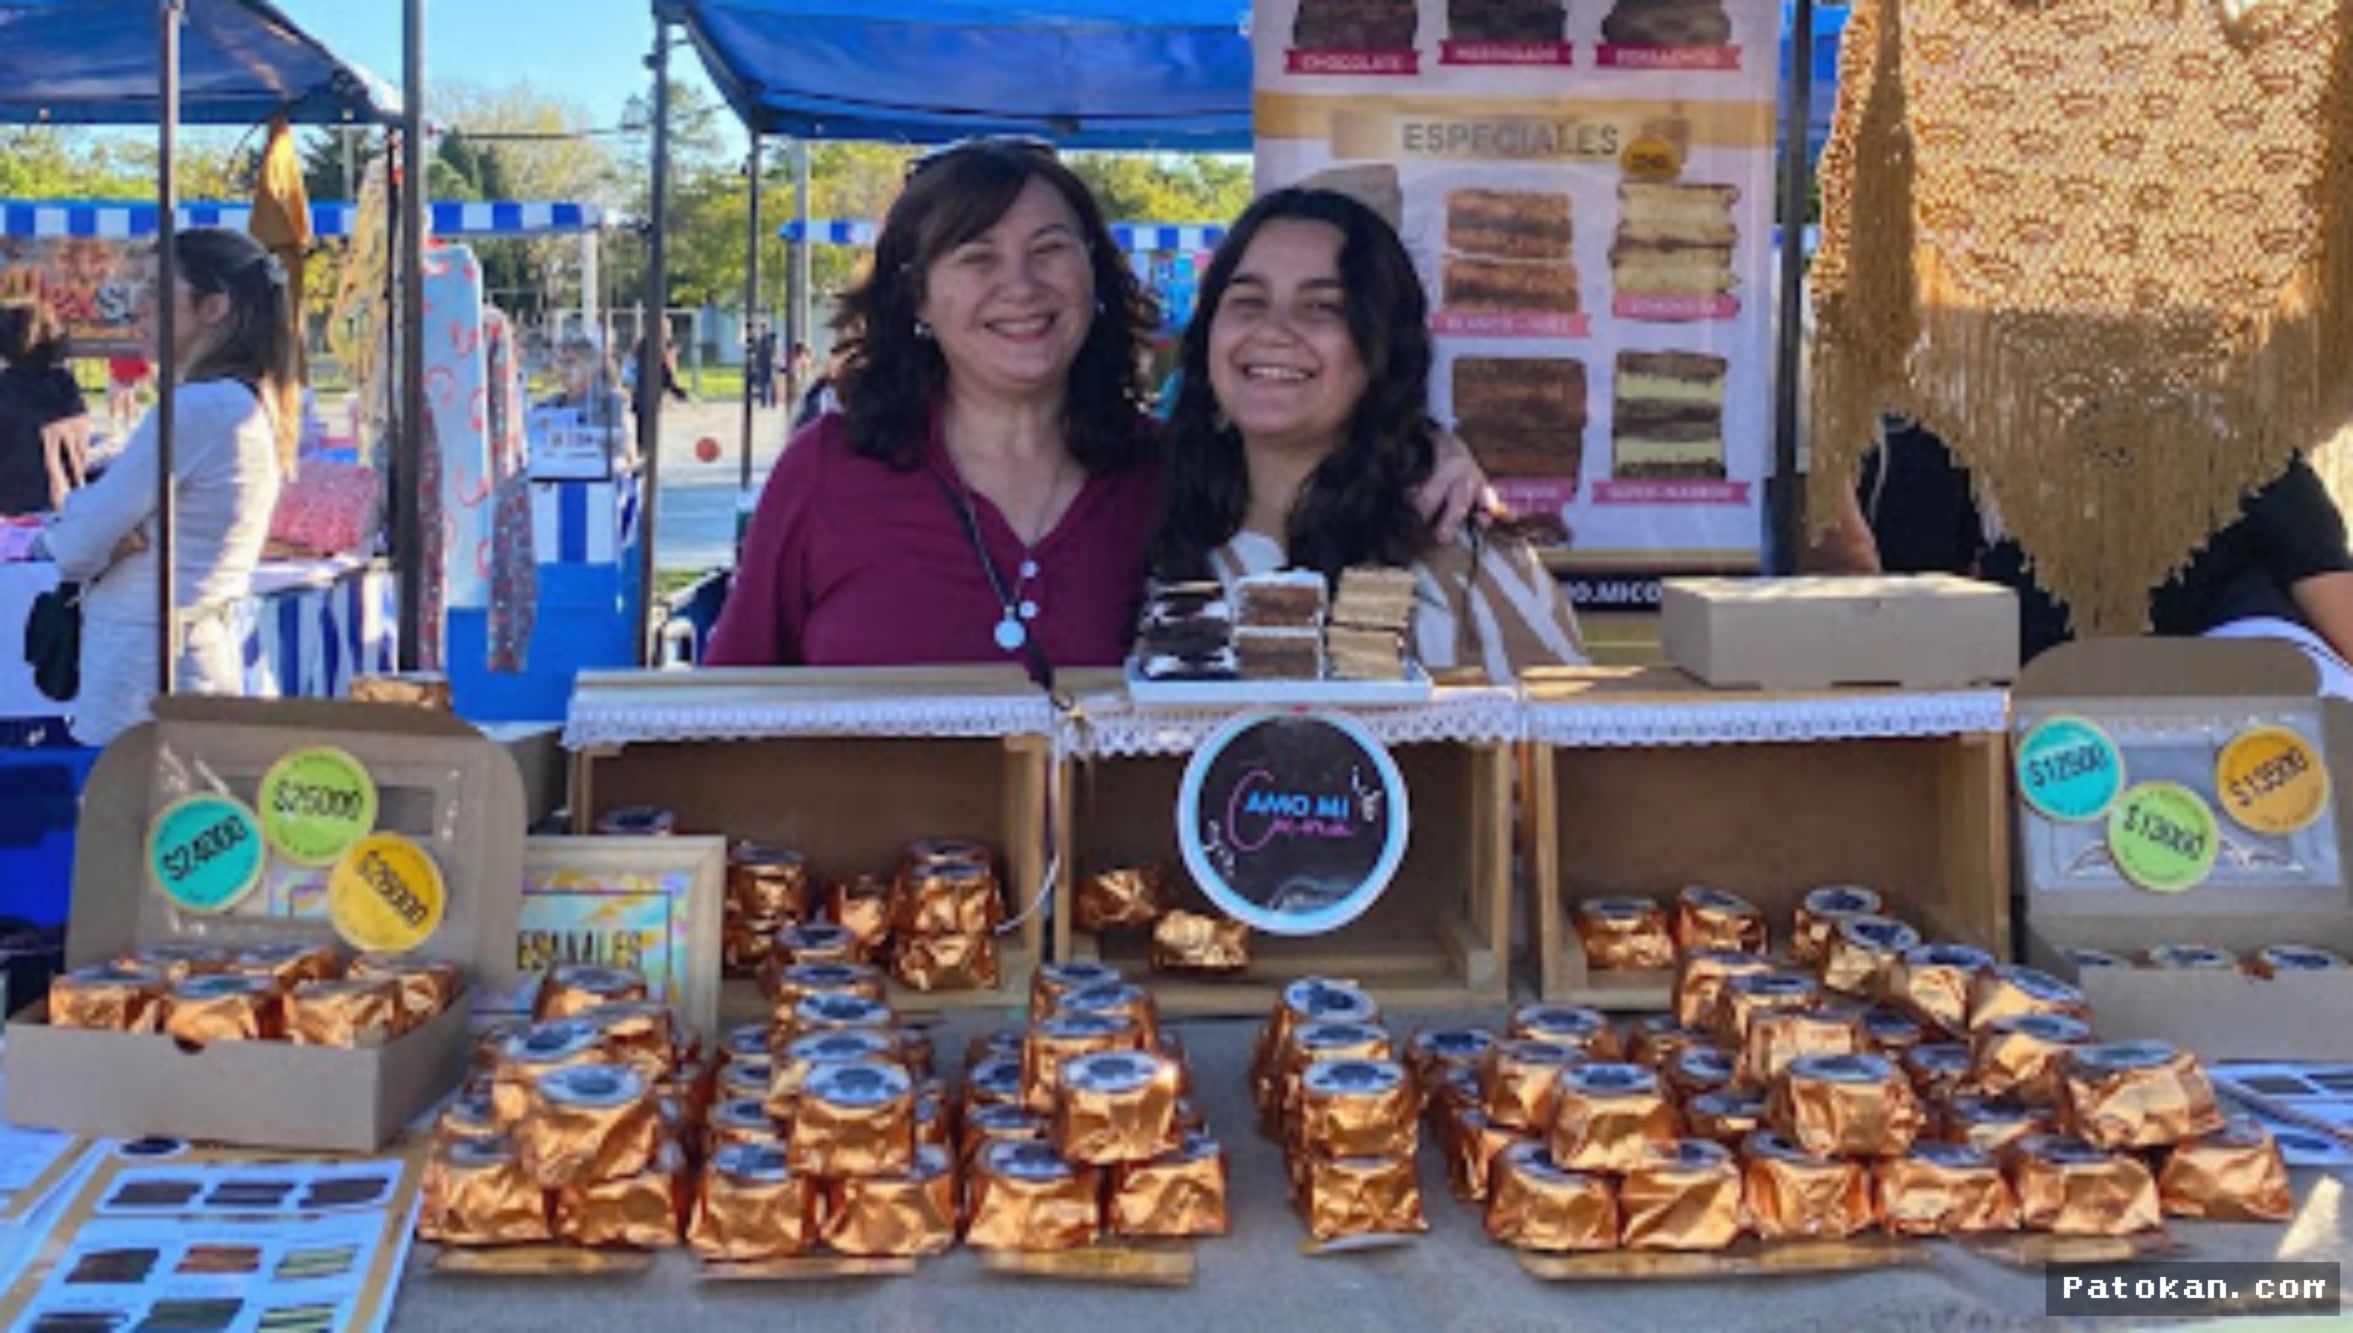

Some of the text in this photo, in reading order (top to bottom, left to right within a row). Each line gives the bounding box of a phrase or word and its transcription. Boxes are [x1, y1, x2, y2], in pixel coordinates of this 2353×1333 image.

[1302, 53, 1402, 71] CHOCOLATE
[1402, 122, 1620, 156] ESPECIALES
[2027, 740, 2109, 788] $12500
[272, 779, 364, 822] $25000
[1243, 790, 1349, 820] AMO MI
[161, 814, 249, 883] $24000
